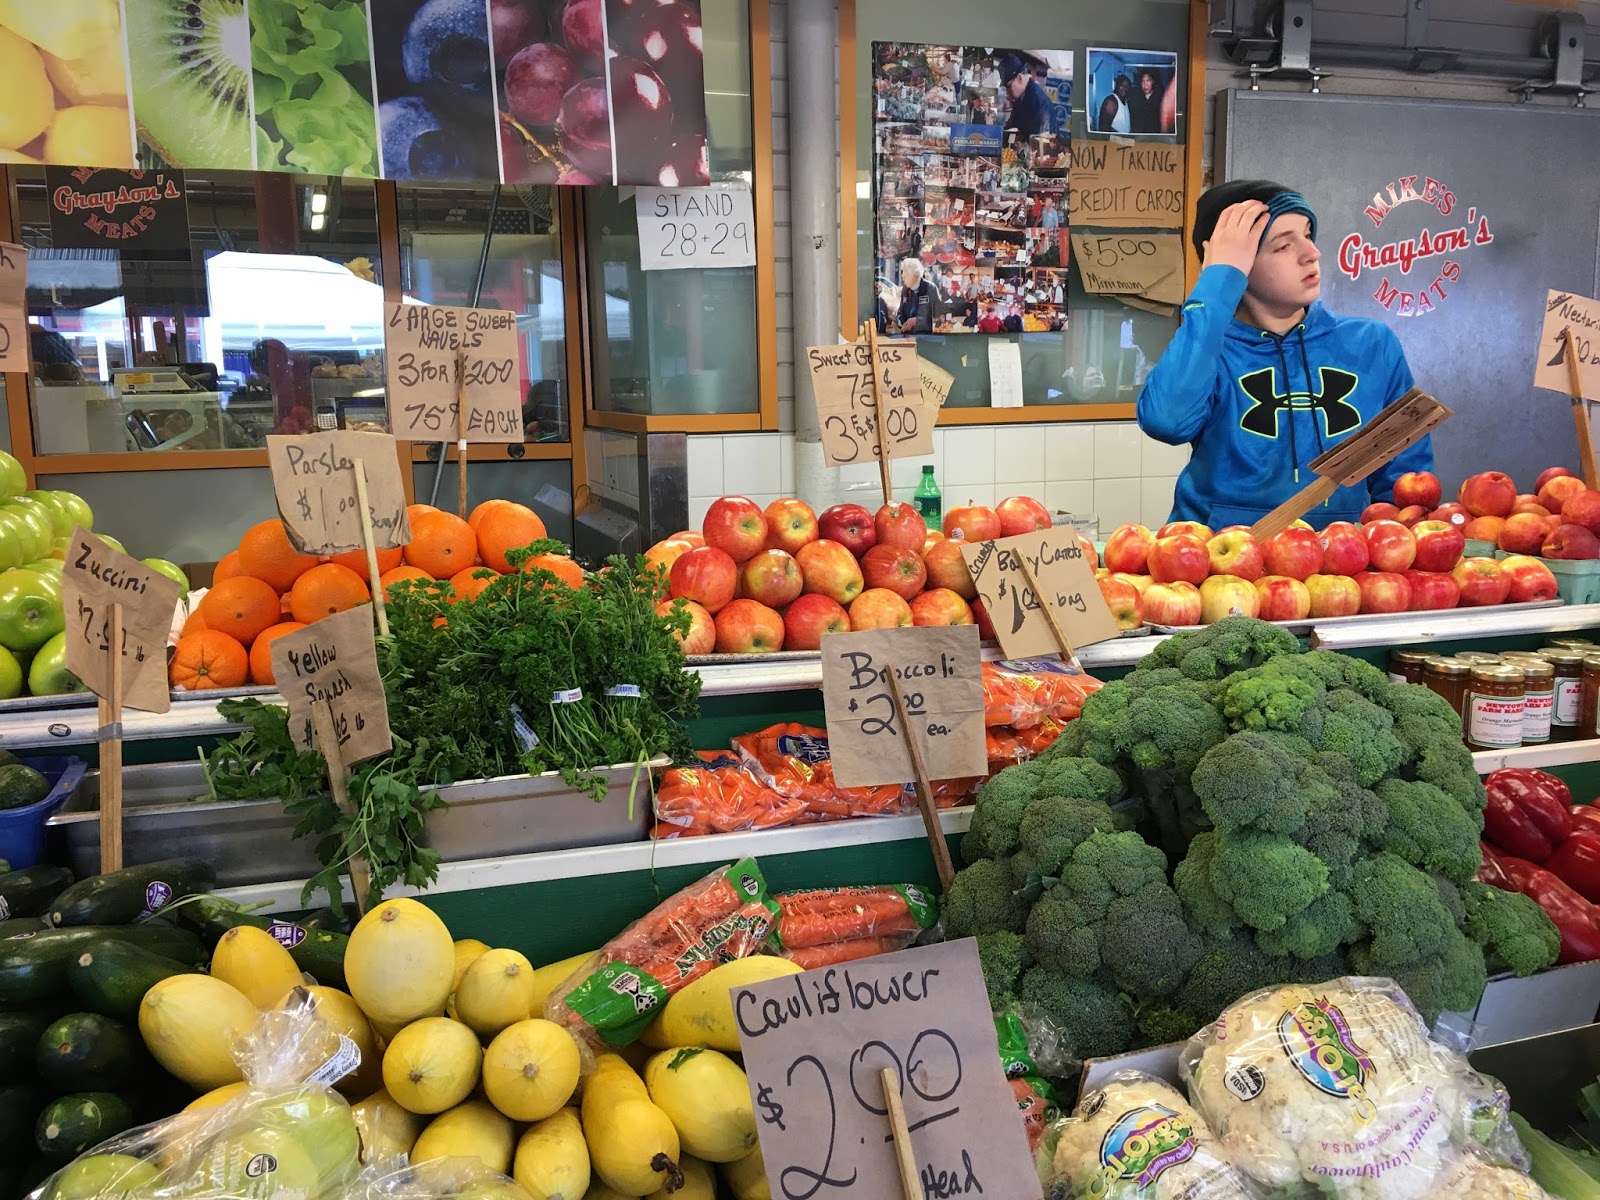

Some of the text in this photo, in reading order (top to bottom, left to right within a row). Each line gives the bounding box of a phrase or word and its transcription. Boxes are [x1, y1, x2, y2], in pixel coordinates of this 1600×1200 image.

[1071, 145, 1178, 173] NOW TAKING
[53, 174, 180, 215] Grayson's
[654, 193, 734, 218] STAND
[1070, 186, 1183, 213] CREDIT CARDS
[1363, 175, 1457, 227] MIKE'S
[84, 205, 157, 239] MEATS
[1081, 237, 1157, 268] $5.00
[1338, 206, 1494, 281] Grayson's
[1373, 260, 1461, 317] MEATS
[389, 304, 458, 332] LARGE
[418, 330, 484, 351] NAVELS
[466, 407, 520, 434] EACH
[996, 549, 1040, 578] Bay
[287, 642, 337, 677] Yellow
[736, 967, 940, 1037] Cauliflower
[921, 1148, 984, 1200] Head
